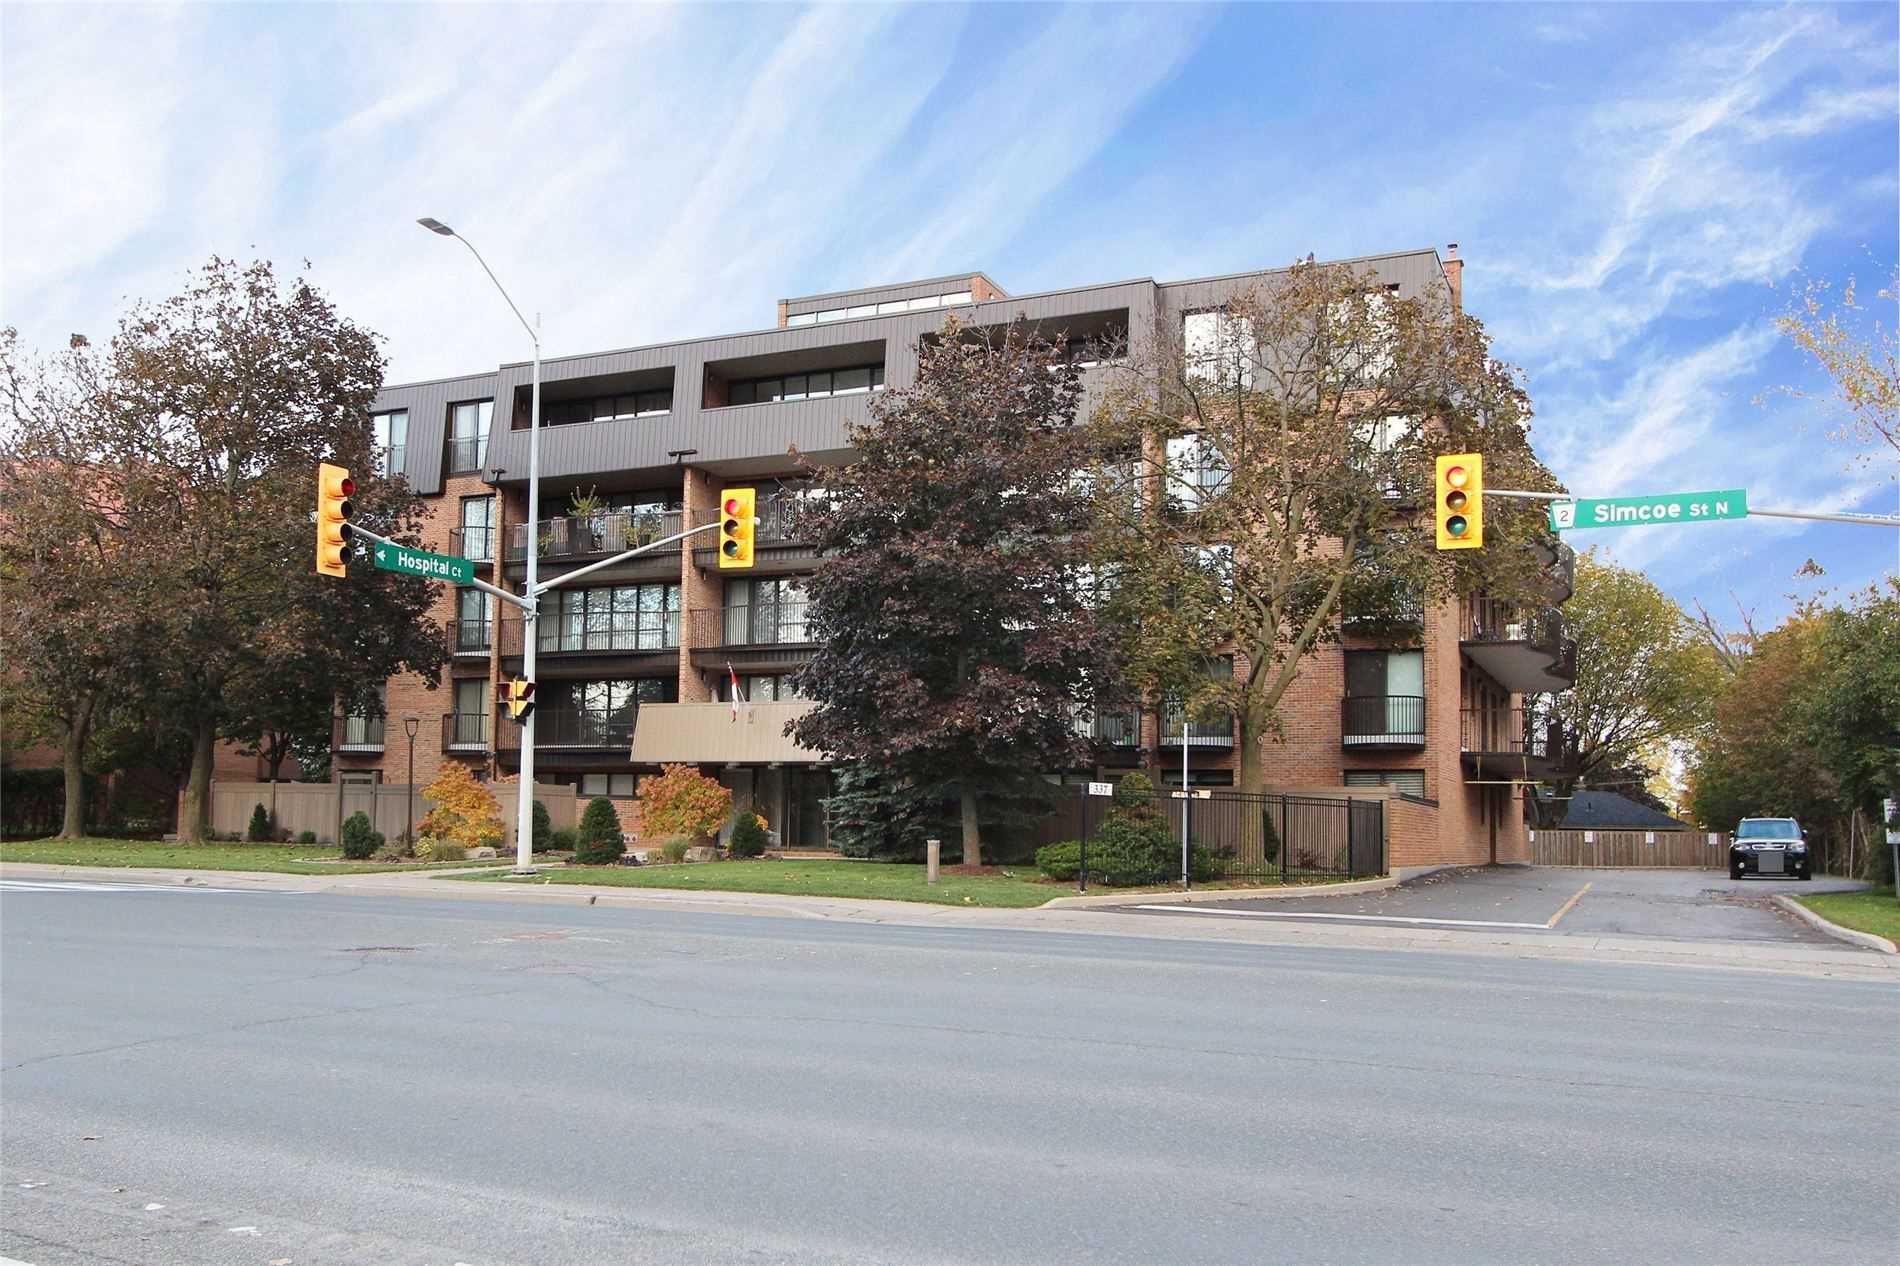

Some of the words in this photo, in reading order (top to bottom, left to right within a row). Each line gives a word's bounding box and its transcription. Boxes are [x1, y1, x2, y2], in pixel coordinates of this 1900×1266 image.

[1560, 510, 1569, 522] 2
[1593, 503, 1681, 523] Simcoe
[1689, 503, 1709, 517] St
[1715, 501, 1729, 515] N
[398, 551, 449, 575] Hospital
[451, 566, 462, 577] Ct
[1094, 784, 1109, 794] 337
